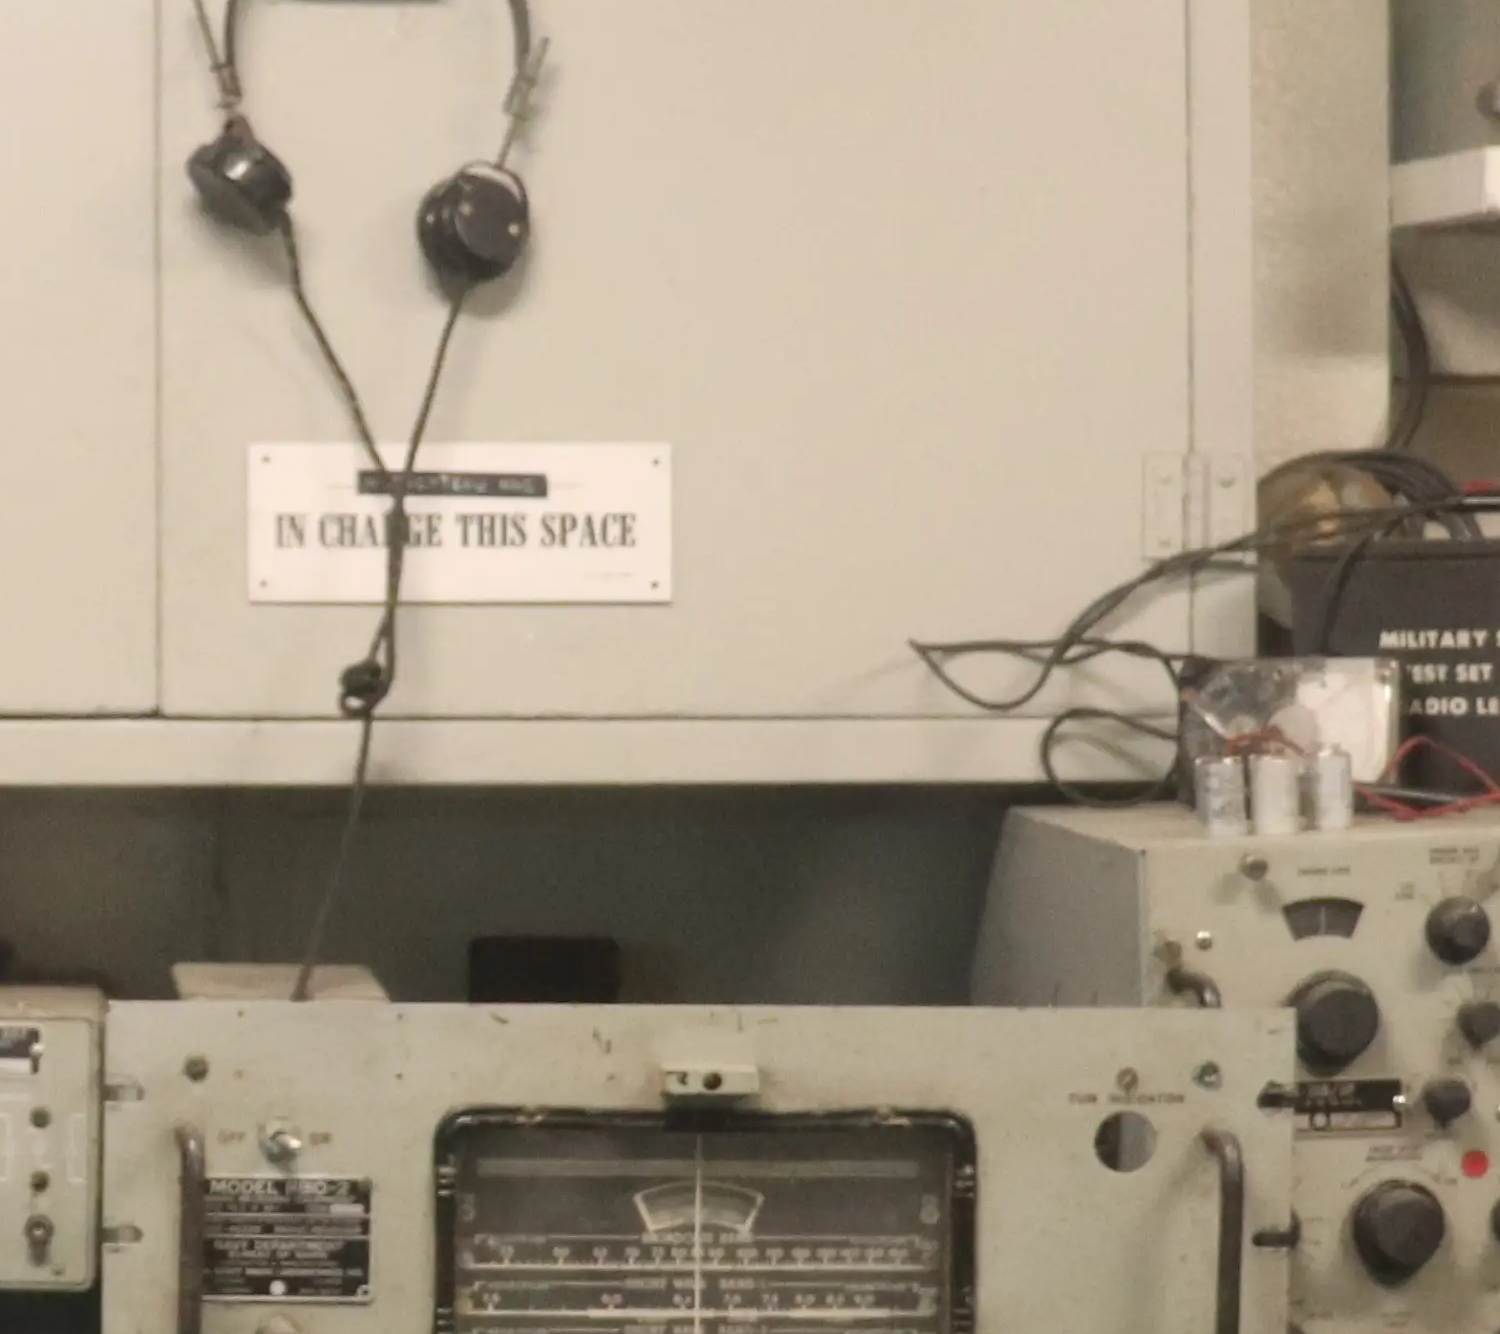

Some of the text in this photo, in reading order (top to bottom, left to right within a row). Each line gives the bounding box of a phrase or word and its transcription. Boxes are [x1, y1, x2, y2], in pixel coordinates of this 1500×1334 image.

[274, 511, 638, 550] IN CHAGE THIS SPACE
[1378, 628, 1489, 650] MILITARY
[1406, 662, 1449, 684] EST
[1455, 662, 1494, 683] SET
[1408, 696, 1469, 716] ADIO
[208, 1178, 280, 1196] MODEL
